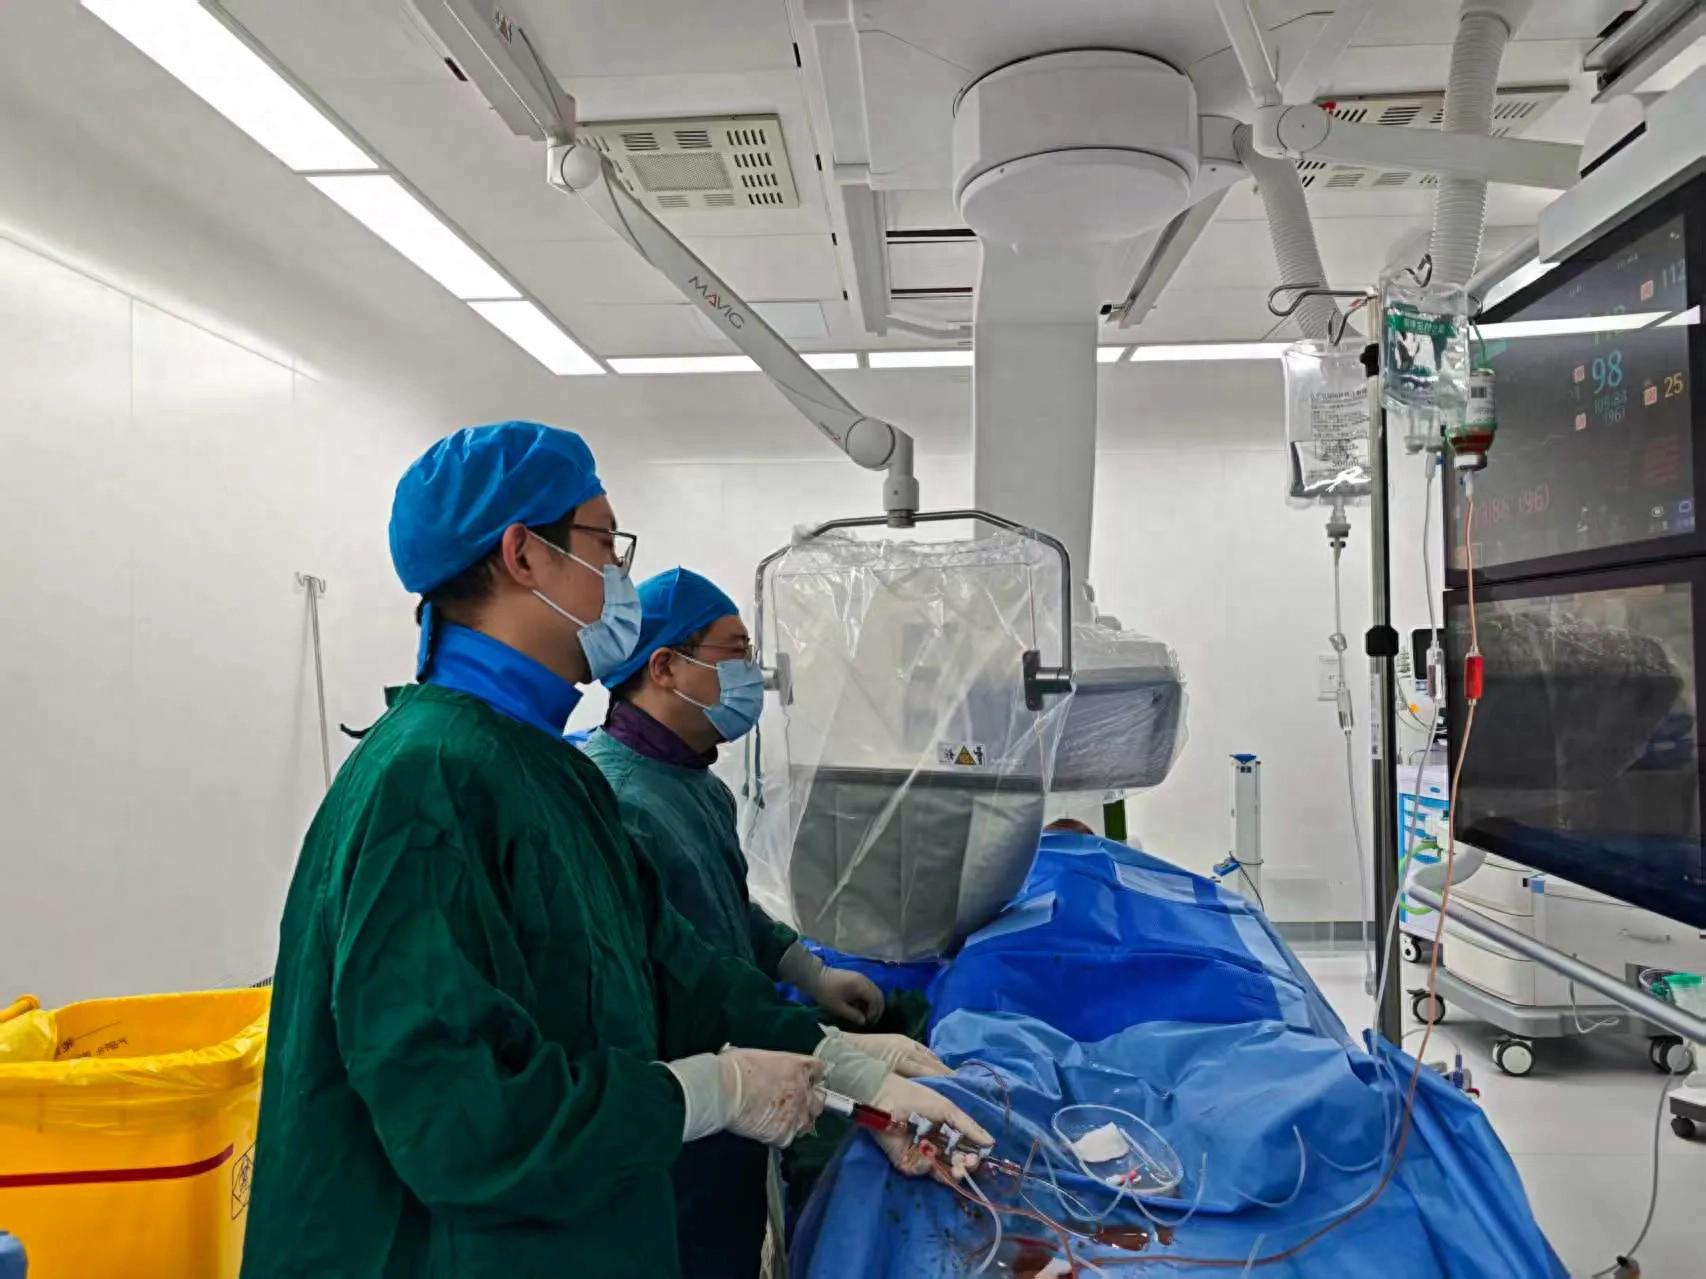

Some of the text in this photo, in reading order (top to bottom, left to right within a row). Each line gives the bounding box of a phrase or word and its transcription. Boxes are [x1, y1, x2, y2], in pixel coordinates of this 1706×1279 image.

[688, 275, 745, 329] MAVIC
[1591, 350, 1623, 394] 98
[1663, 372, 1685, 399] 25
